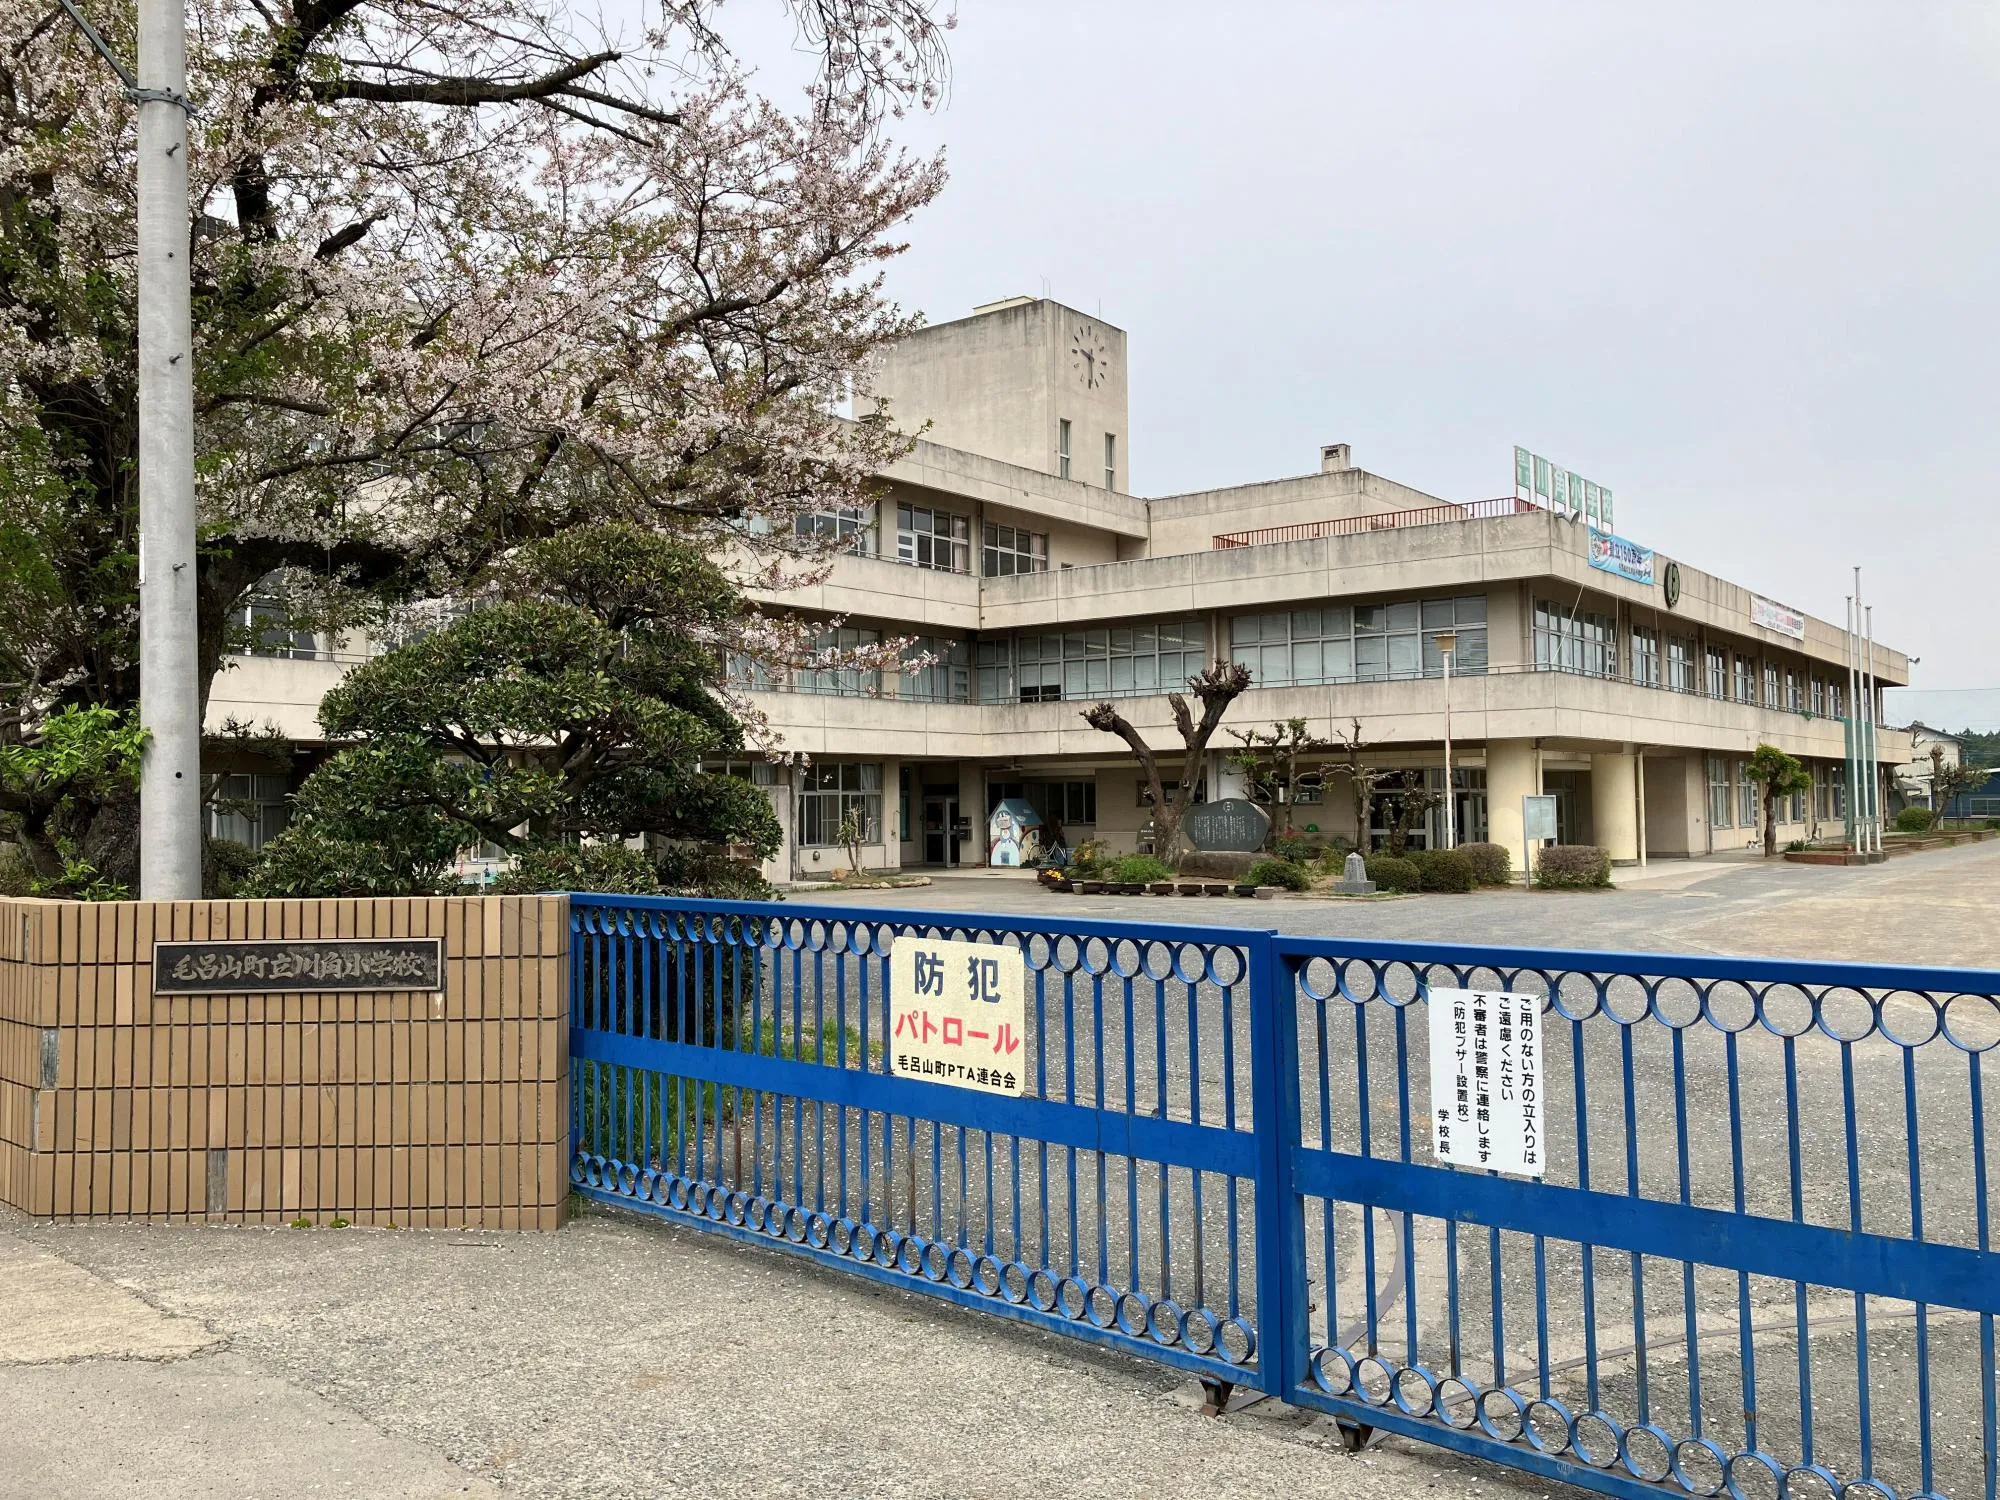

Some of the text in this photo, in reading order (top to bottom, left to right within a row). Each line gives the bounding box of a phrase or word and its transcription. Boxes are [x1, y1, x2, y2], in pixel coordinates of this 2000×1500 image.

[172, 949, 423, 980] 毛呂山町立川角小学校
[914, 951, 1001, 1004] 防犯
[895, 1010, 1020, 1055] パトロール
[1499, 997, 1514, 1101] ご遠慮ください
[898, 1055, 1016, 1090] 毛呂山町PTA連合会
[1473, 994, 1491, 1163] 不審者は警察に連絡します
[1520, 998, 1537, 1164] ご用のない方の立入りは
[1438, 1109, 1450, 1154] 学校長
